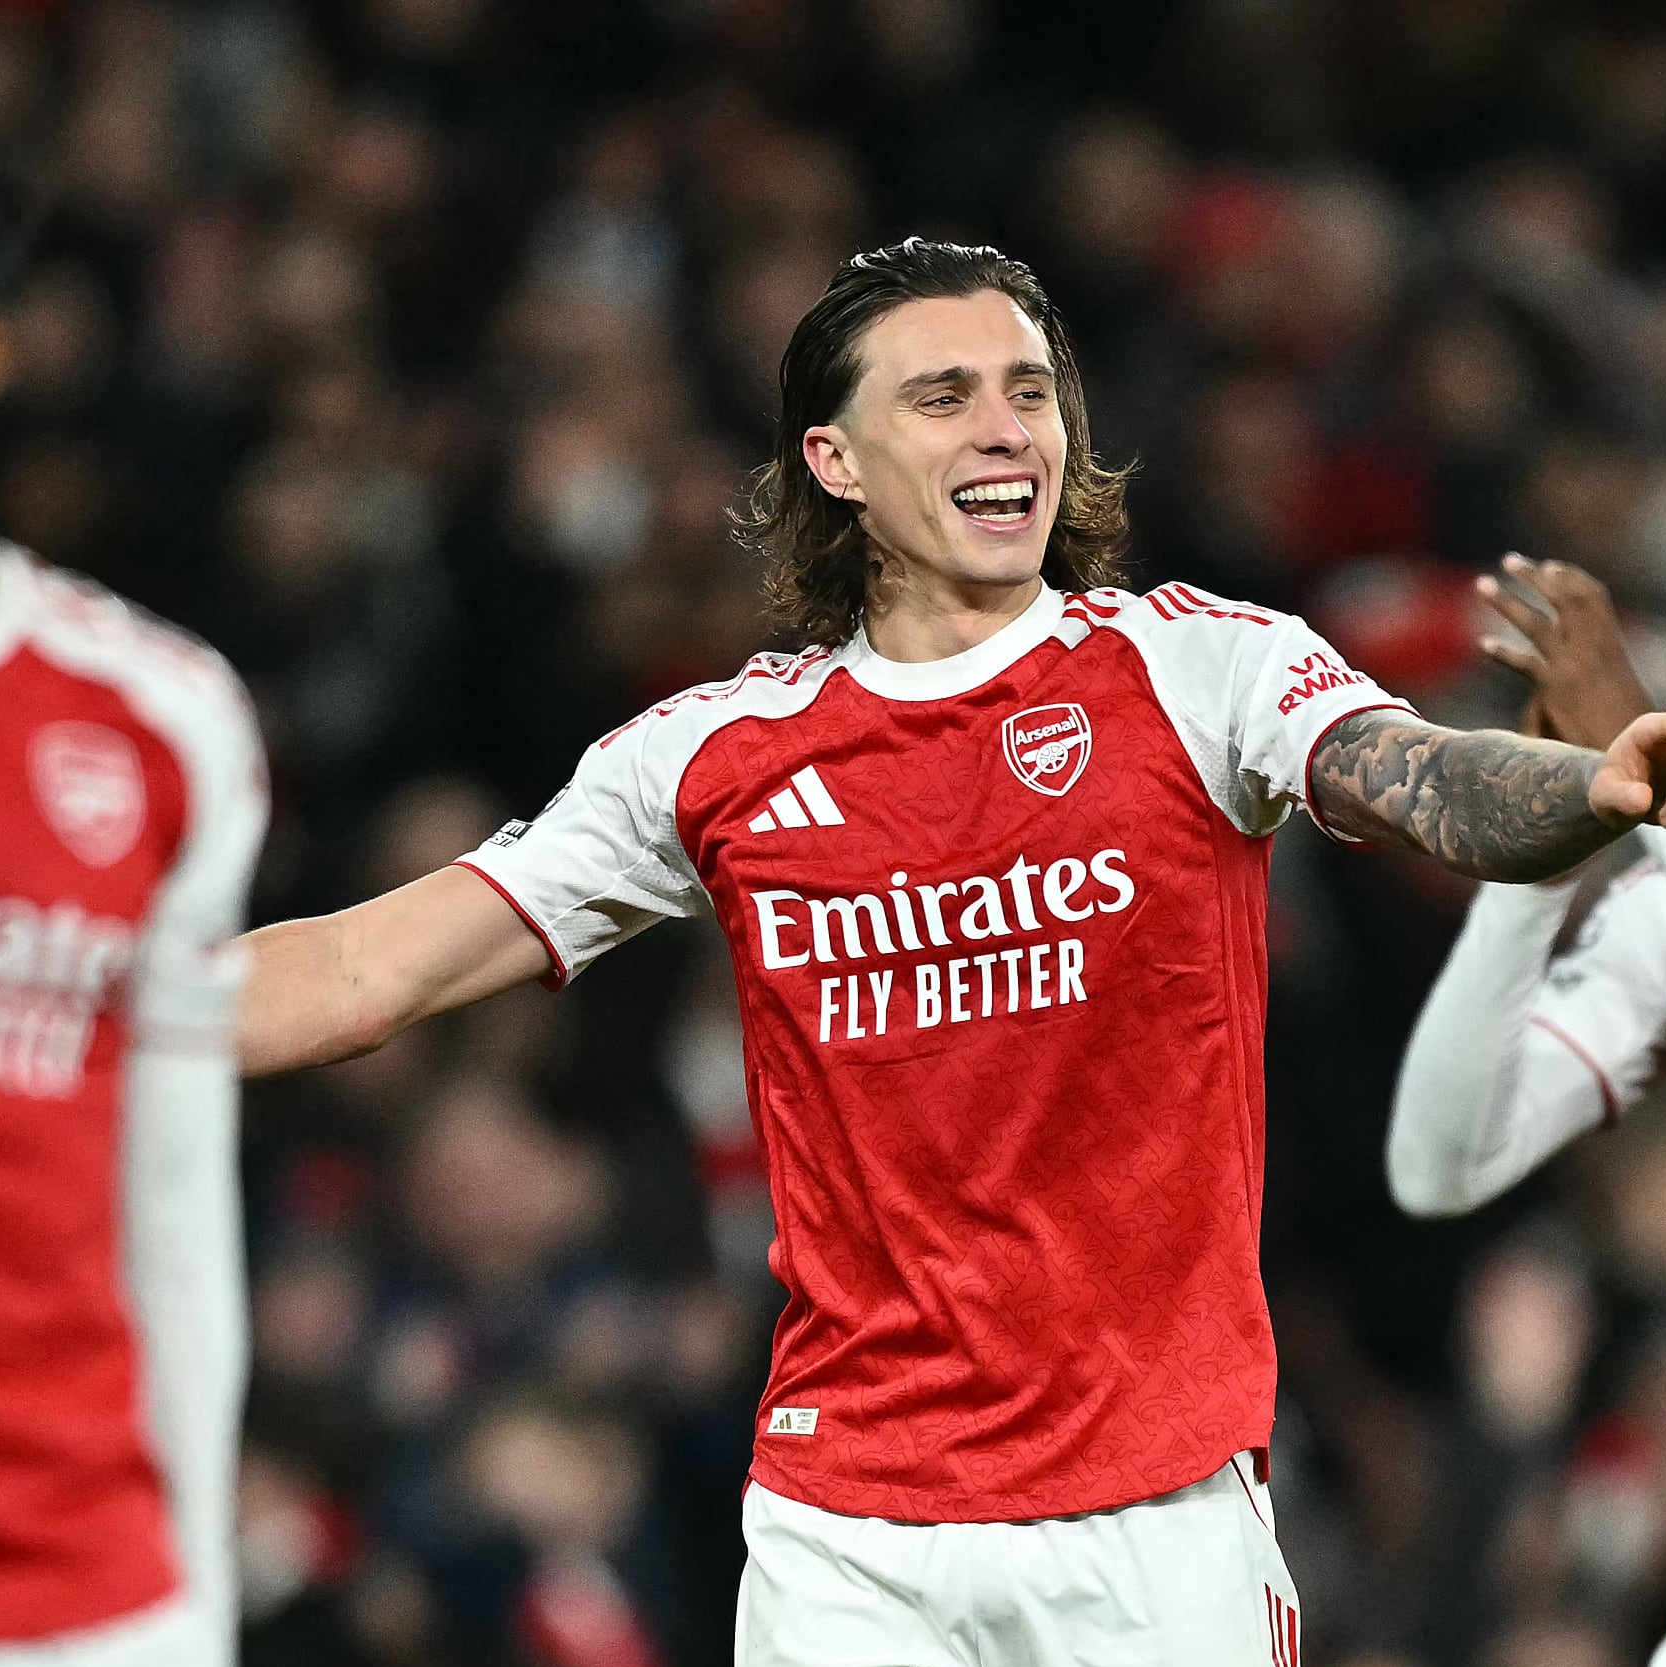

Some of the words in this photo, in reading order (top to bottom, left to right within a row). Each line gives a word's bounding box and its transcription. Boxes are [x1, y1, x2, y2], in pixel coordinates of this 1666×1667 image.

[1015, 715, 1077, 746] Arsenal
[749, 847, 1135, 970] Emirates
[819, 973, 892, 1043] FLY
[915, 938, 1089, 1031] BETTER
